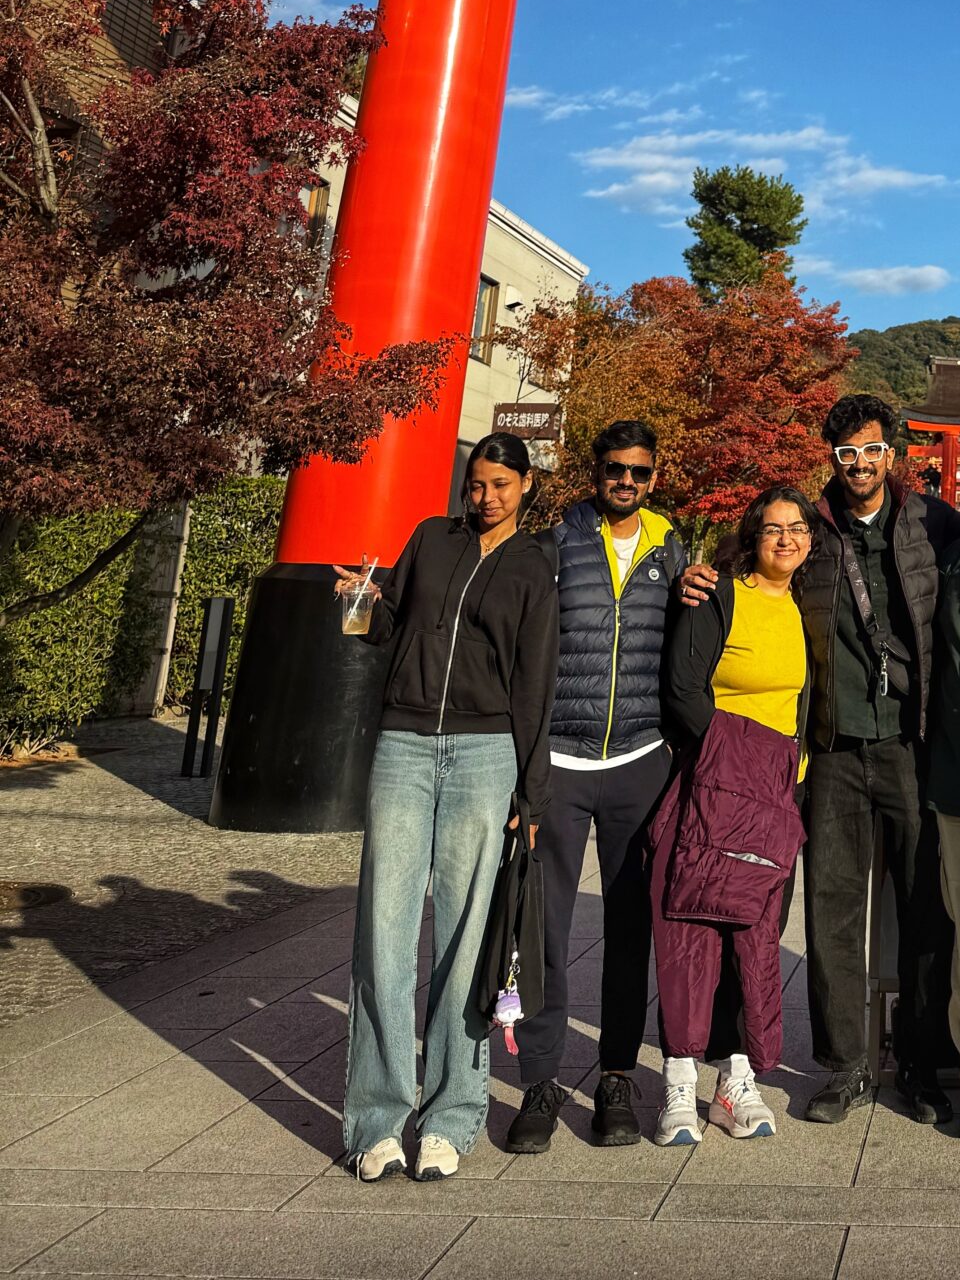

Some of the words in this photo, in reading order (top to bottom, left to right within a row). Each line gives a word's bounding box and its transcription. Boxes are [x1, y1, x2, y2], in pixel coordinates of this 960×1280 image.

[497, 412, 549, 428] のぞえ歯科医院
